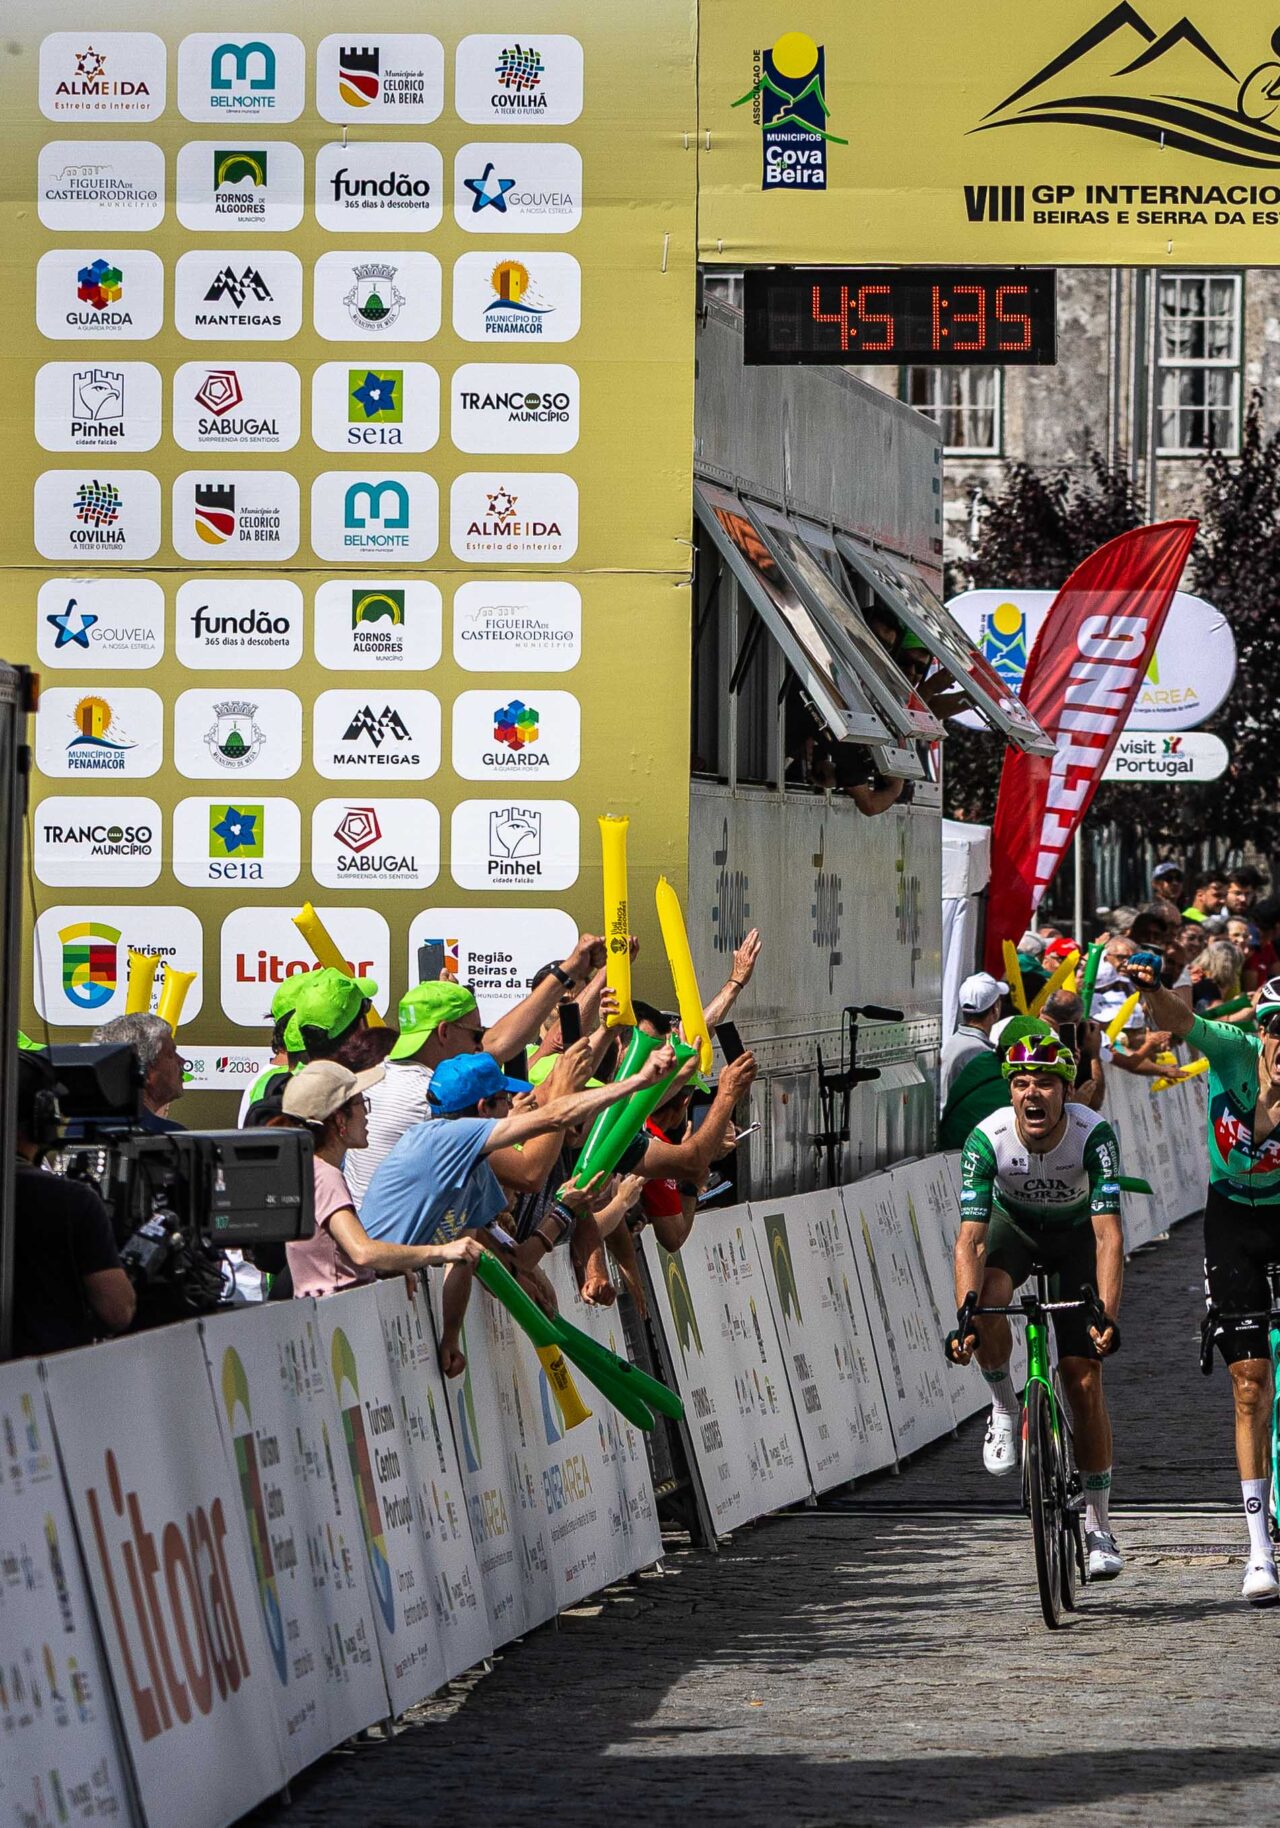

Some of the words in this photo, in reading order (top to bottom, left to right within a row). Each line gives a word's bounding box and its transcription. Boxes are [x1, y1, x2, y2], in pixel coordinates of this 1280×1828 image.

[753, 50, 760, 62] DE
[56, 82, 149, 95] ALMEIDA
[384, 80, 424, 91] CELORICO
[211, 96, 275, 108] BELMONTE
[384, 93, 395, 104] DA
[399, 93, 423, 104] BEIRA
[491, 93, 547, 107] COVILHÃ
[767, 146, 822, 164] Cova
[767, 165, 824, 182] Beira
[331, 168, 430, 201] fundão
[216, 194, 254, 203] FORNOS
[345, 200, 359, 209] 365
[362, 200, 377, 209] dias
[387, 200, 429, 209] descoberta
[509, 193, 572, 205] GOUVEIA
[964, 186, 1025, 222] VIII
[1032, 186, 1075, 204] GP
[215, 204, 265, 214] ALGODRES
[1034, 211, 1110, 224] BEIRAS
[1117, 211, 1129, 224] E
[1136, 211, 1208, 224] SERRA
[1214, 212, 1246, 225] DA
[66, 312, 132, 325] GUARDA
[196, 315, 281, 325] MANTEIGAS
[486, 314, 529, 323] MUNICÍPIO
[531, 315, 542, 323] DE
[486, 324, 542, 334] PENAMACOR
[461, 393, 569, 410] TRANCOSO
[508, 410, 569, 422] MUNICÍPIO
[71, 423, 125, 437] Pinhel
[198, 419, 279, 435] SABUGAL
[348, 427, 403, 445] seia
[240, 517, 280, 528] CELORICO
[467, 522, 561, 536] ALMEIDA
[70, 528, 125, 543] COVILHÃ
[240, 530, 251, 541] DA
[255, 530, 280, 541] BEIRA
[345, 535, 409, 546] BELMONTE
[191, 605, 290, 638] fundão
[91, 629, 155, 641] GOUVEIA
[354, 633, 391, 642] FORNOS
[353, 643, 403, 652] ALGODRES
[68, 749, 111, 758] MUNICÍPIO
[1120, 740, 1157, 755] visit
[68, 759, 125, 769] PENAMACOR
[334, 754, 420, 765] MANTEIGAS
[482, 753, 549, 766] GUARDA
[1116, 758, 1194, 777] Portugal
[44, 826, 152, 843] TRANCOSO
[91, 843, 152, 855] MUNICÍPIO
[337, 855, 418, 872] SABUGAL
[488, 860, 542, 875] Pinhel
[208, 861, 264, 880] seia
[468, 952, 512, 964] Região
[468, 965, 507, 975] Beiras
[468, 978, 501, 988] Serra
[506, 978, 521, 988] da
[229, 1061, 259, 1074] 2030
[1024, 1179, 1069, 1191] CAJA
